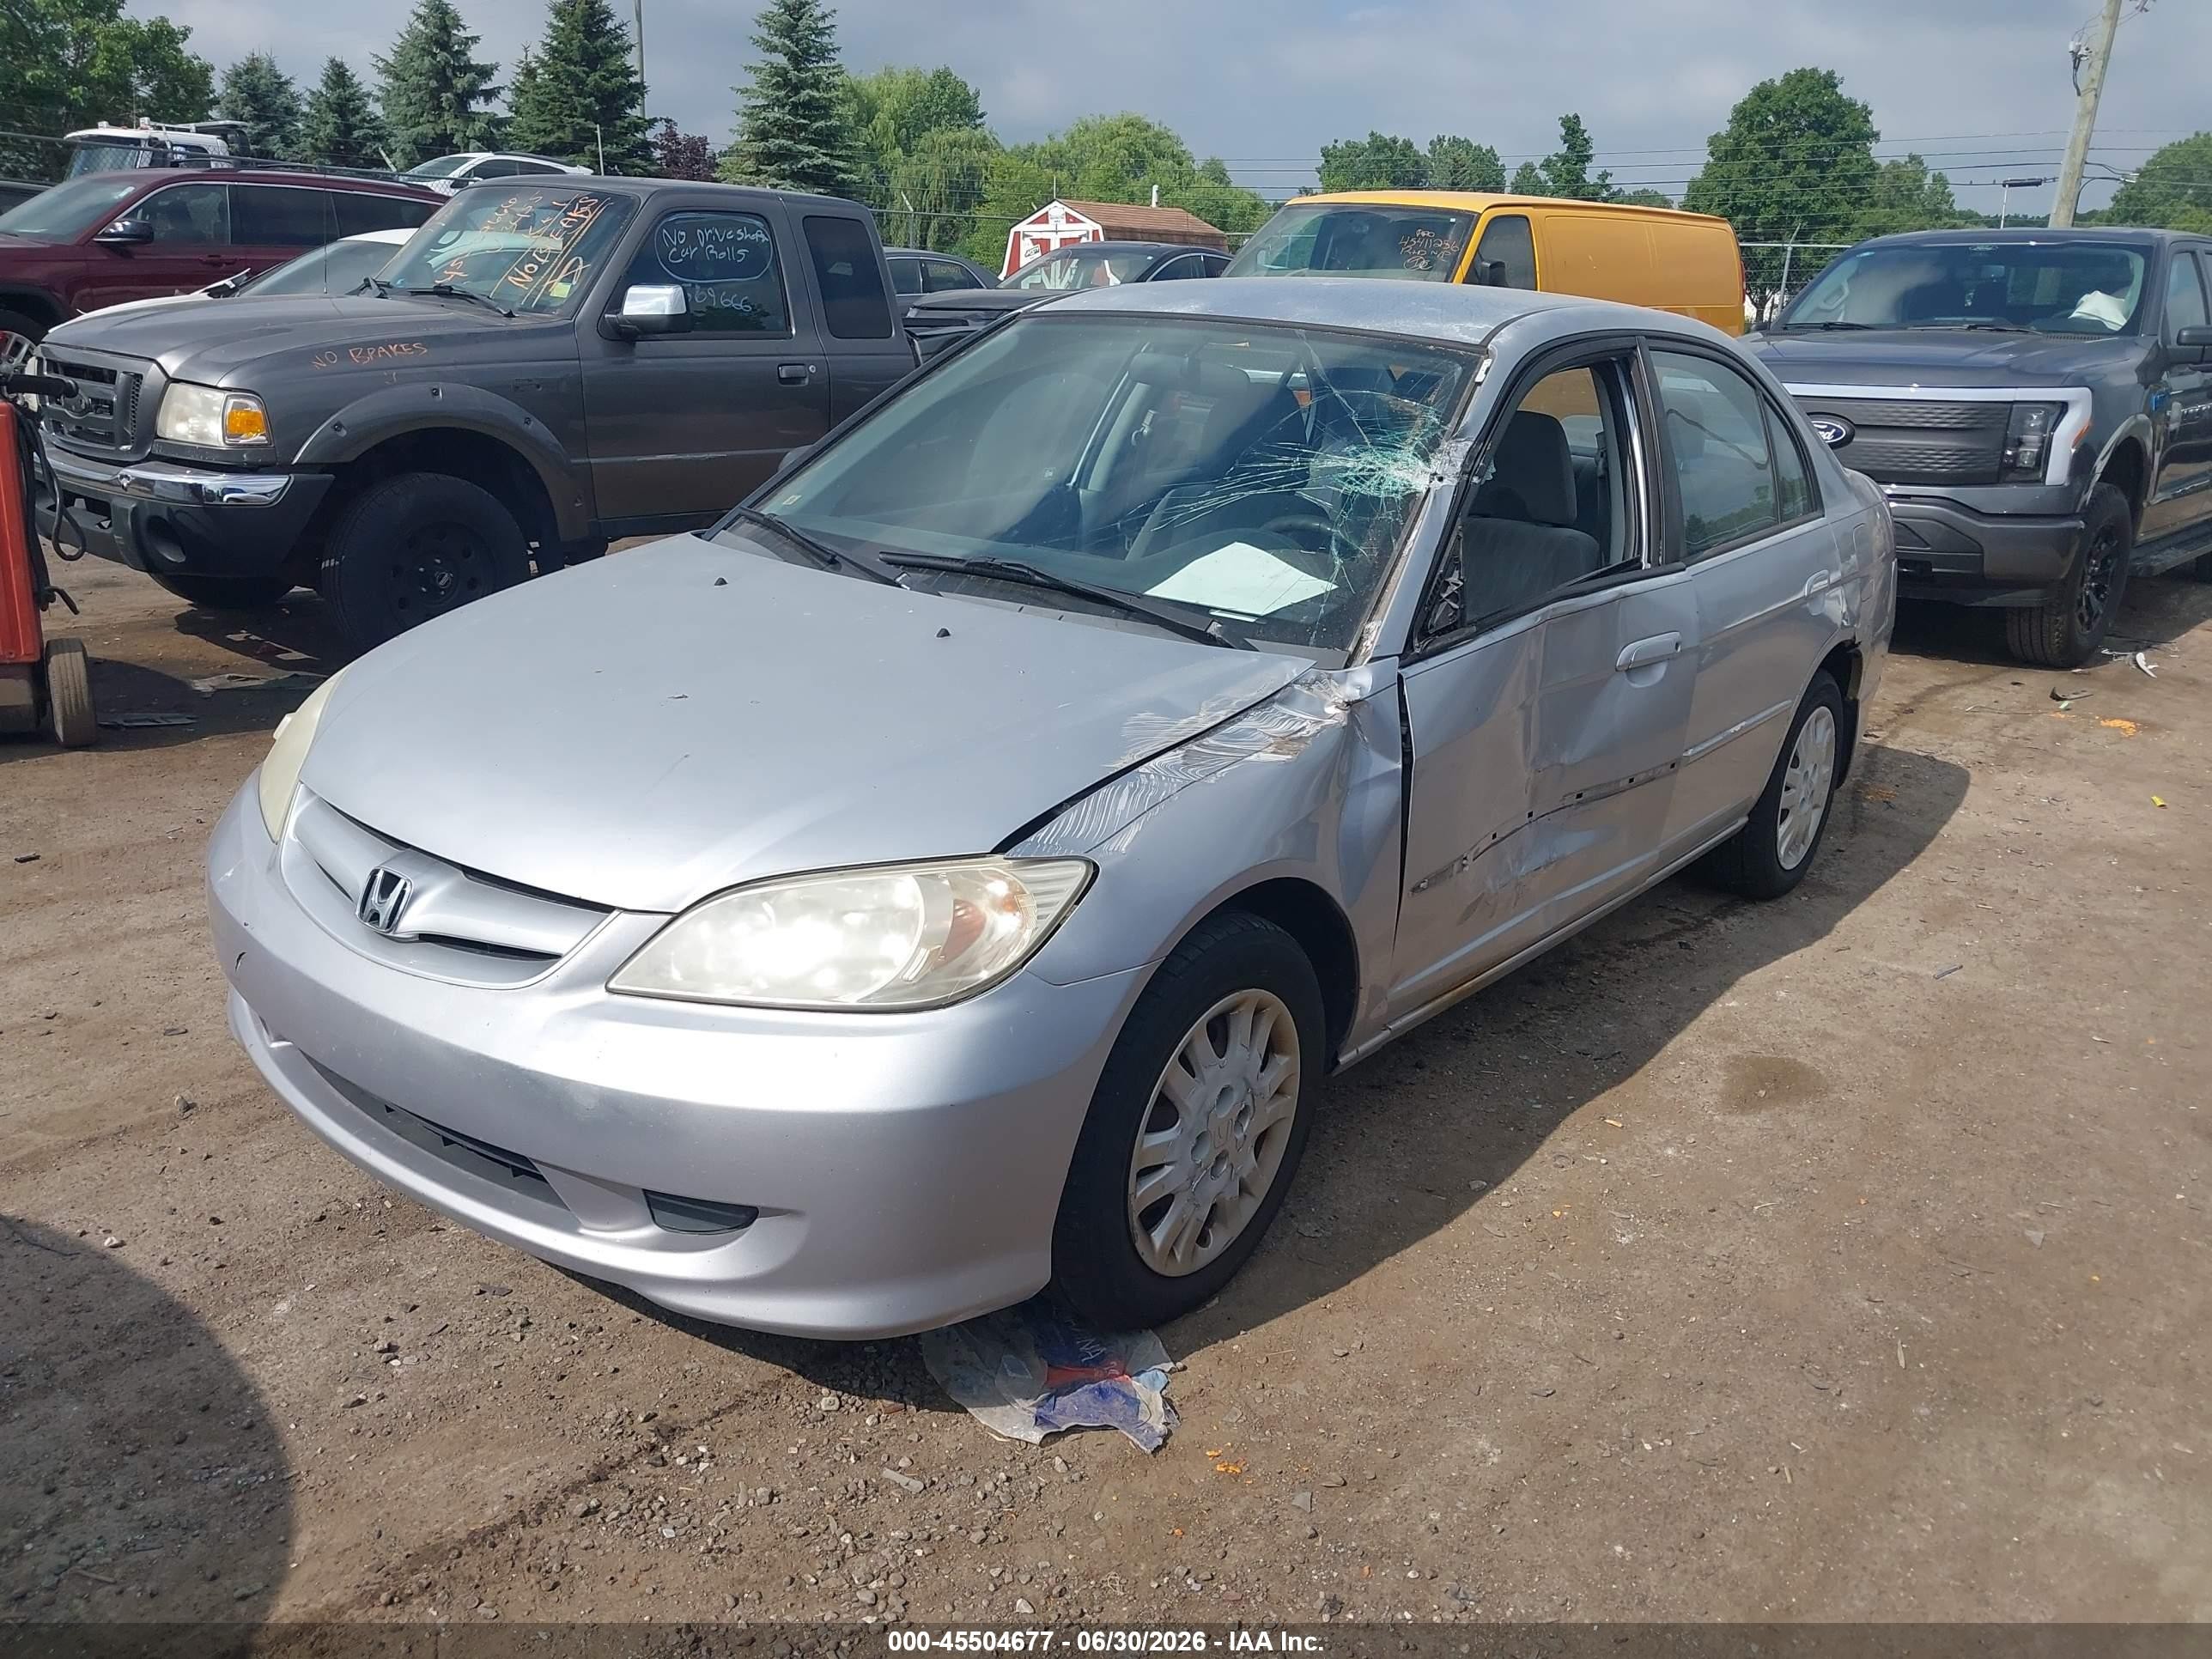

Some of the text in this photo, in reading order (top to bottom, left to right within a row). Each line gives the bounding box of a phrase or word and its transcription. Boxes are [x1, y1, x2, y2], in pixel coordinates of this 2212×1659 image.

[662, 228, 686, 248] No
[705, 244, 750, 263] Rolls
[311, 350, 337, 370] NO
